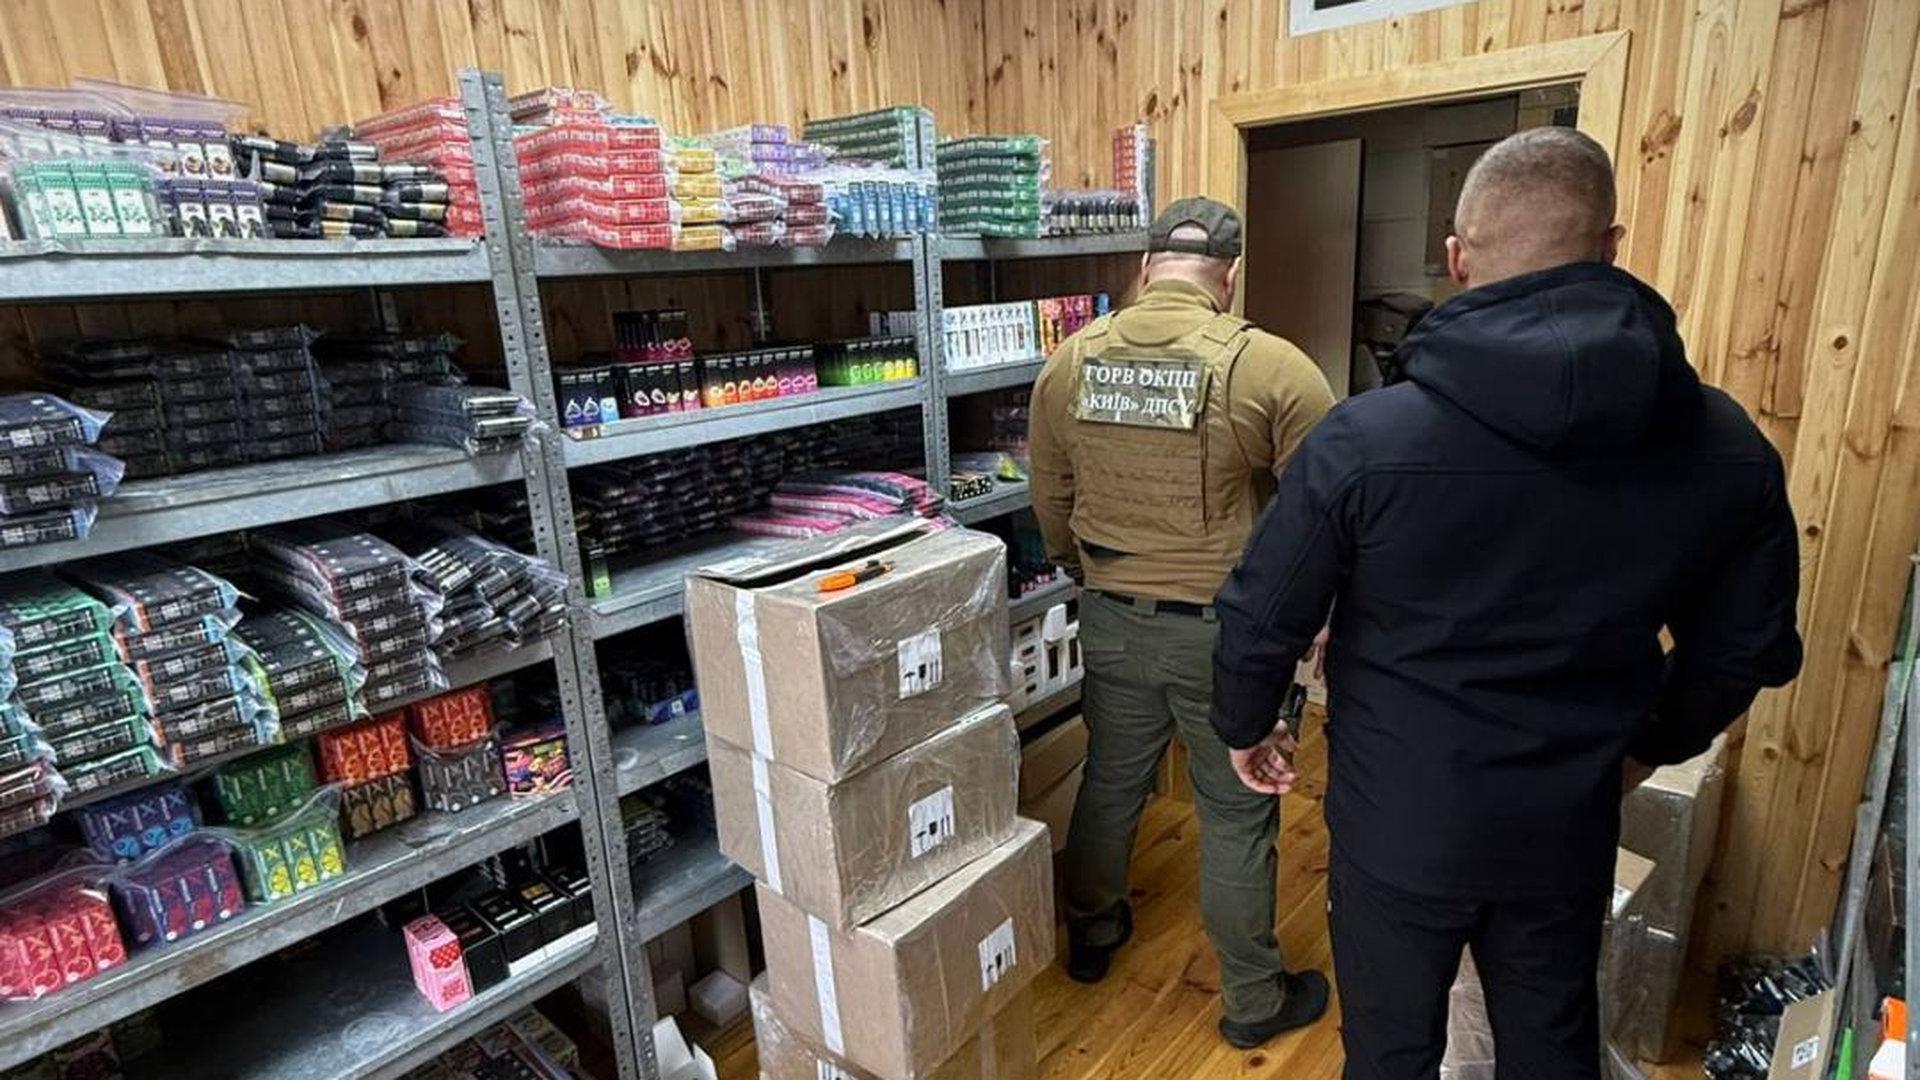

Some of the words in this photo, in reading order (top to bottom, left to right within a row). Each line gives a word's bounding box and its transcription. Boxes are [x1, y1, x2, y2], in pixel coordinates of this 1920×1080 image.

[1085, 365, 1135, 385] ГОРВ
[1138, 367, 1196, 388] ОКПП
[1142, 397, 1195, 417] ДПСУ
